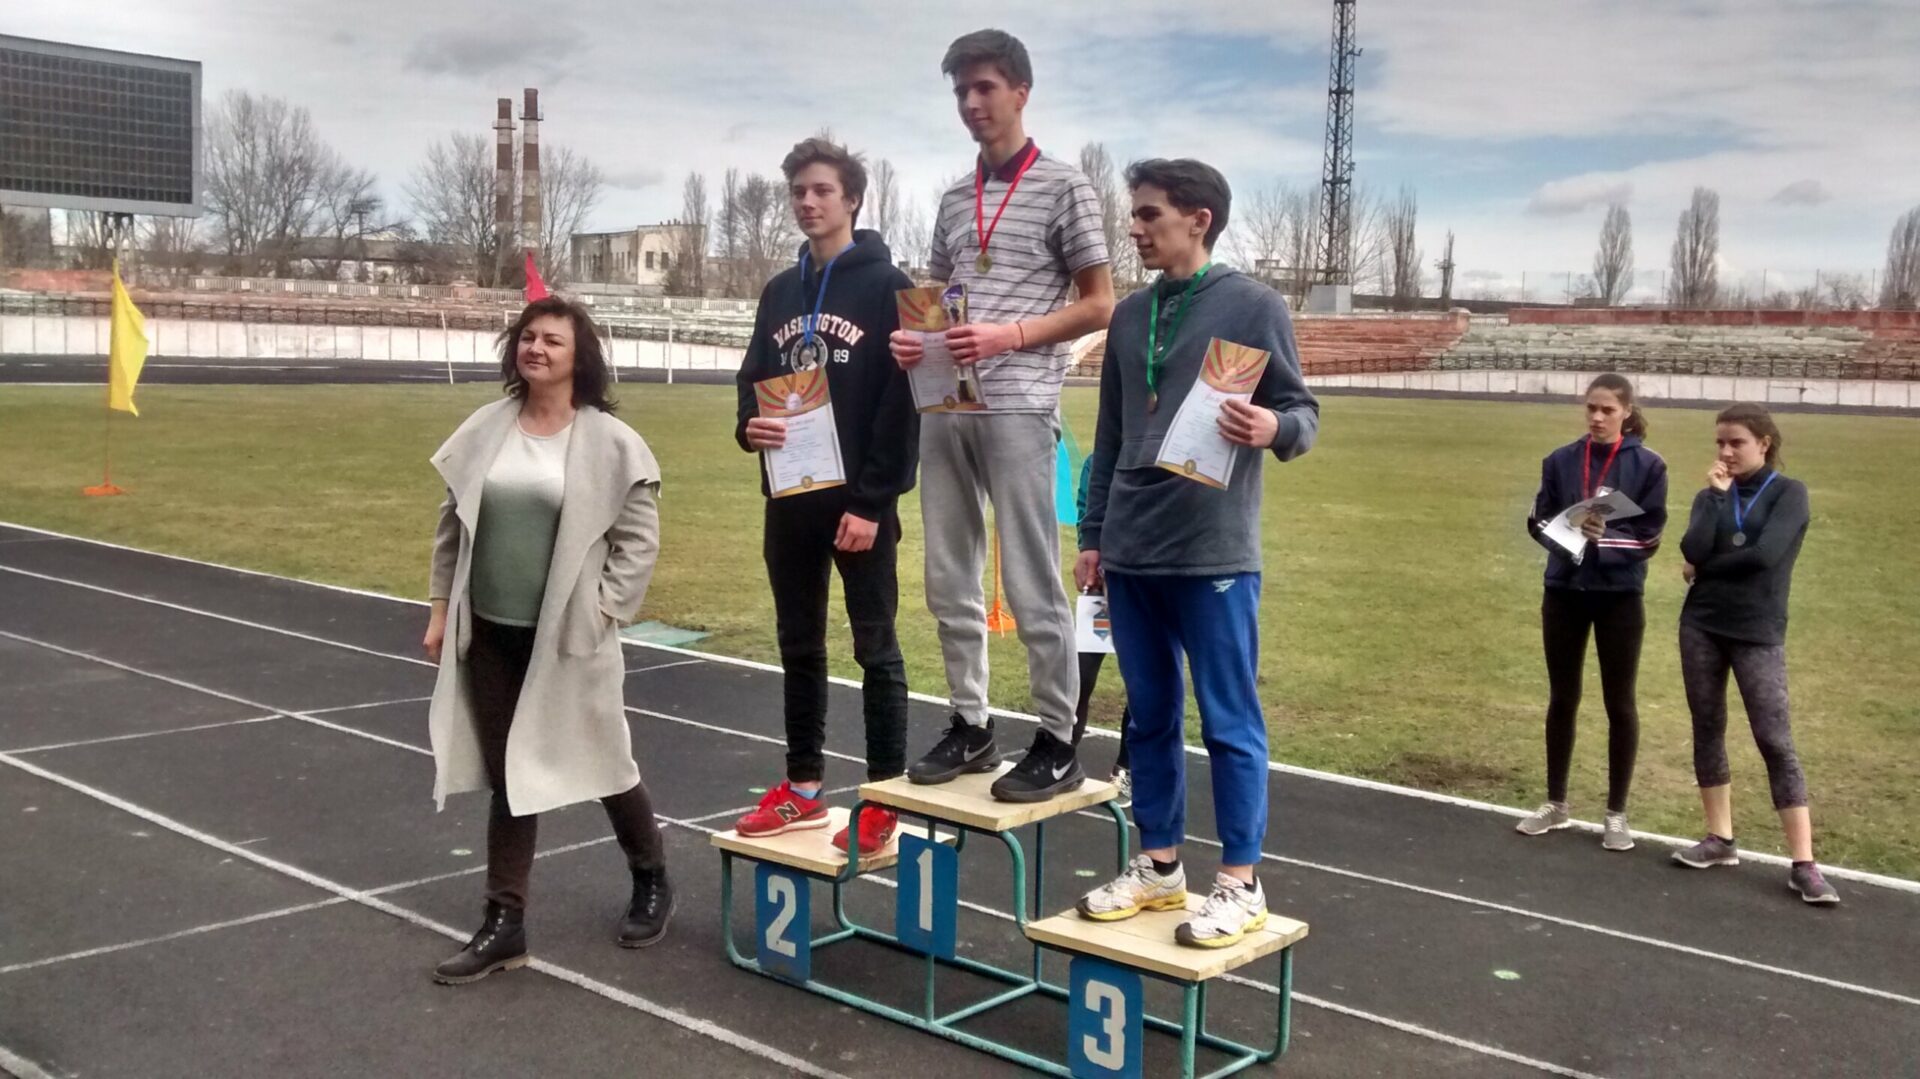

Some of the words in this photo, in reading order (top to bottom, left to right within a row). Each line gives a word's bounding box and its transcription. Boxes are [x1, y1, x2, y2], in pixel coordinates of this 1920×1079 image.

[833, 348, 850, 363] 89
[774, 800, 801, 823] N
[765, 874, 797, 958] 2
[915, 847, 933, 932] 1
[1083, 979, 1127, 1071] 3
